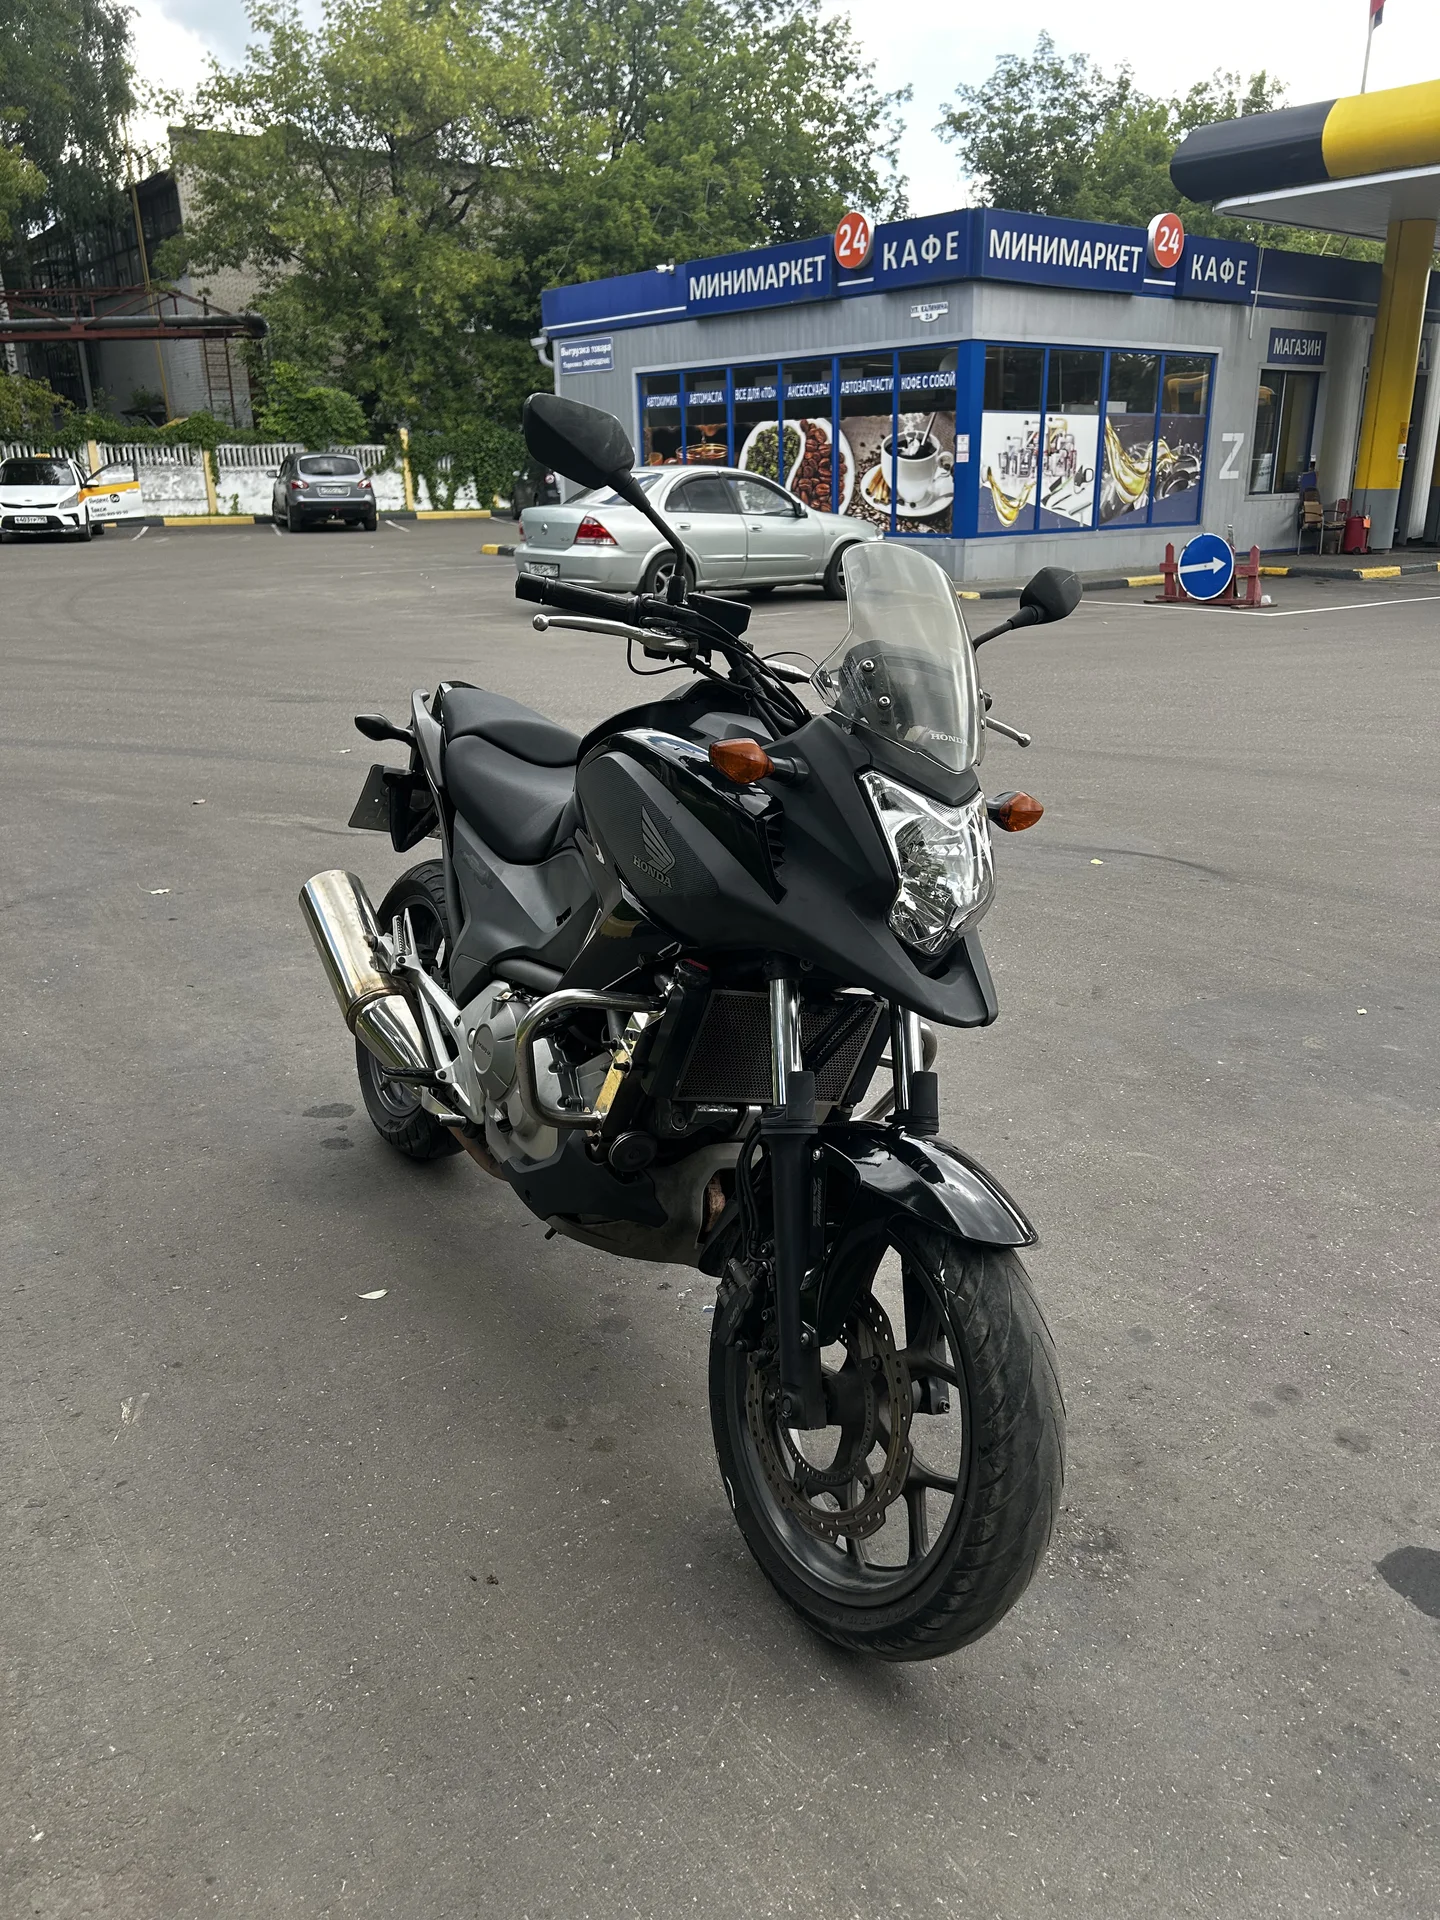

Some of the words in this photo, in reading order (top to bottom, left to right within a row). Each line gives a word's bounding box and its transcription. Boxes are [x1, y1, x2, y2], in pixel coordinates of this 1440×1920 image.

[689, 254, 827, 301] МИНИМАРКЕТ
[838, 221, 867, 257] 24
[882, 230, 960, 271] КАФЕ
[988, 228, 1144, 274] МИНИМАРКЕТ
[1157, 225, 1180, 255] 24
[1191, 253, 1248, 286] КАФЕ
[561, 346, 590, 357] Выгрузка
[1273, 337, 1322, 357] МАГАЗИН
[840, 377, 895, 394] АВТОЗАПЧАСТИ
[901, 374, 921, 390] КОФЕ
[922, 375, 929, 388] С
[929, 371, 956, 388] СОБОЙ
[689, 390, 724, 405] АВТОМАСЛА
[735, 387, 747, 401] ВСЕ
[747, 386, 760, 401] ДЛЯ
[787, 382, 830, 398] АКСЕССУАРЫ
[646, 394, 678, 407] АВТОХИМИЯ
[1219, 432, 1245, 479] Z
[633, 855, 673, 888] HONDA
